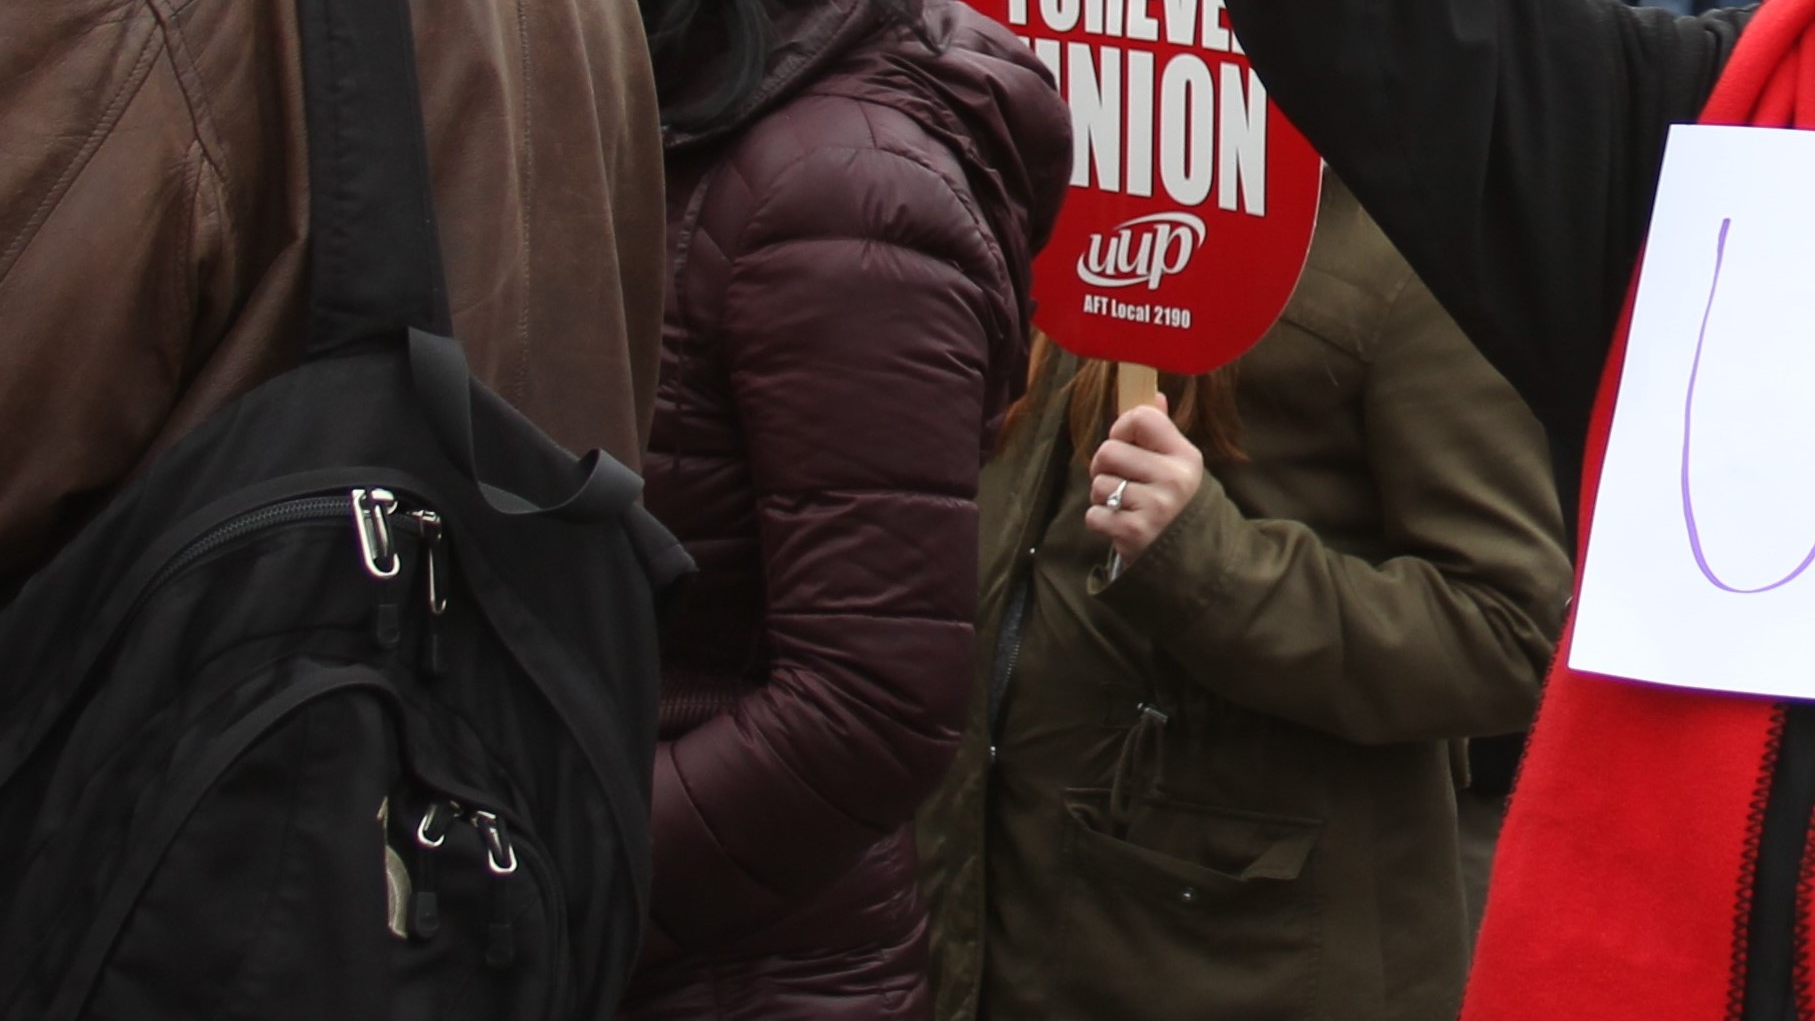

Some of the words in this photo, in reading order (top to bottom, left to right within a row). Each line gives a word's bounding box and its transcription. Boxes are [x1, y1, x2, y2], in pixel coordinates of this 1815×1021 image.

[1086, 221, 1194, 290] uup
[1083, 293, 1109, 316] AFT
[1111, 298, 1151, 323] Local
[1153, 305, 1192, 329] 2190
